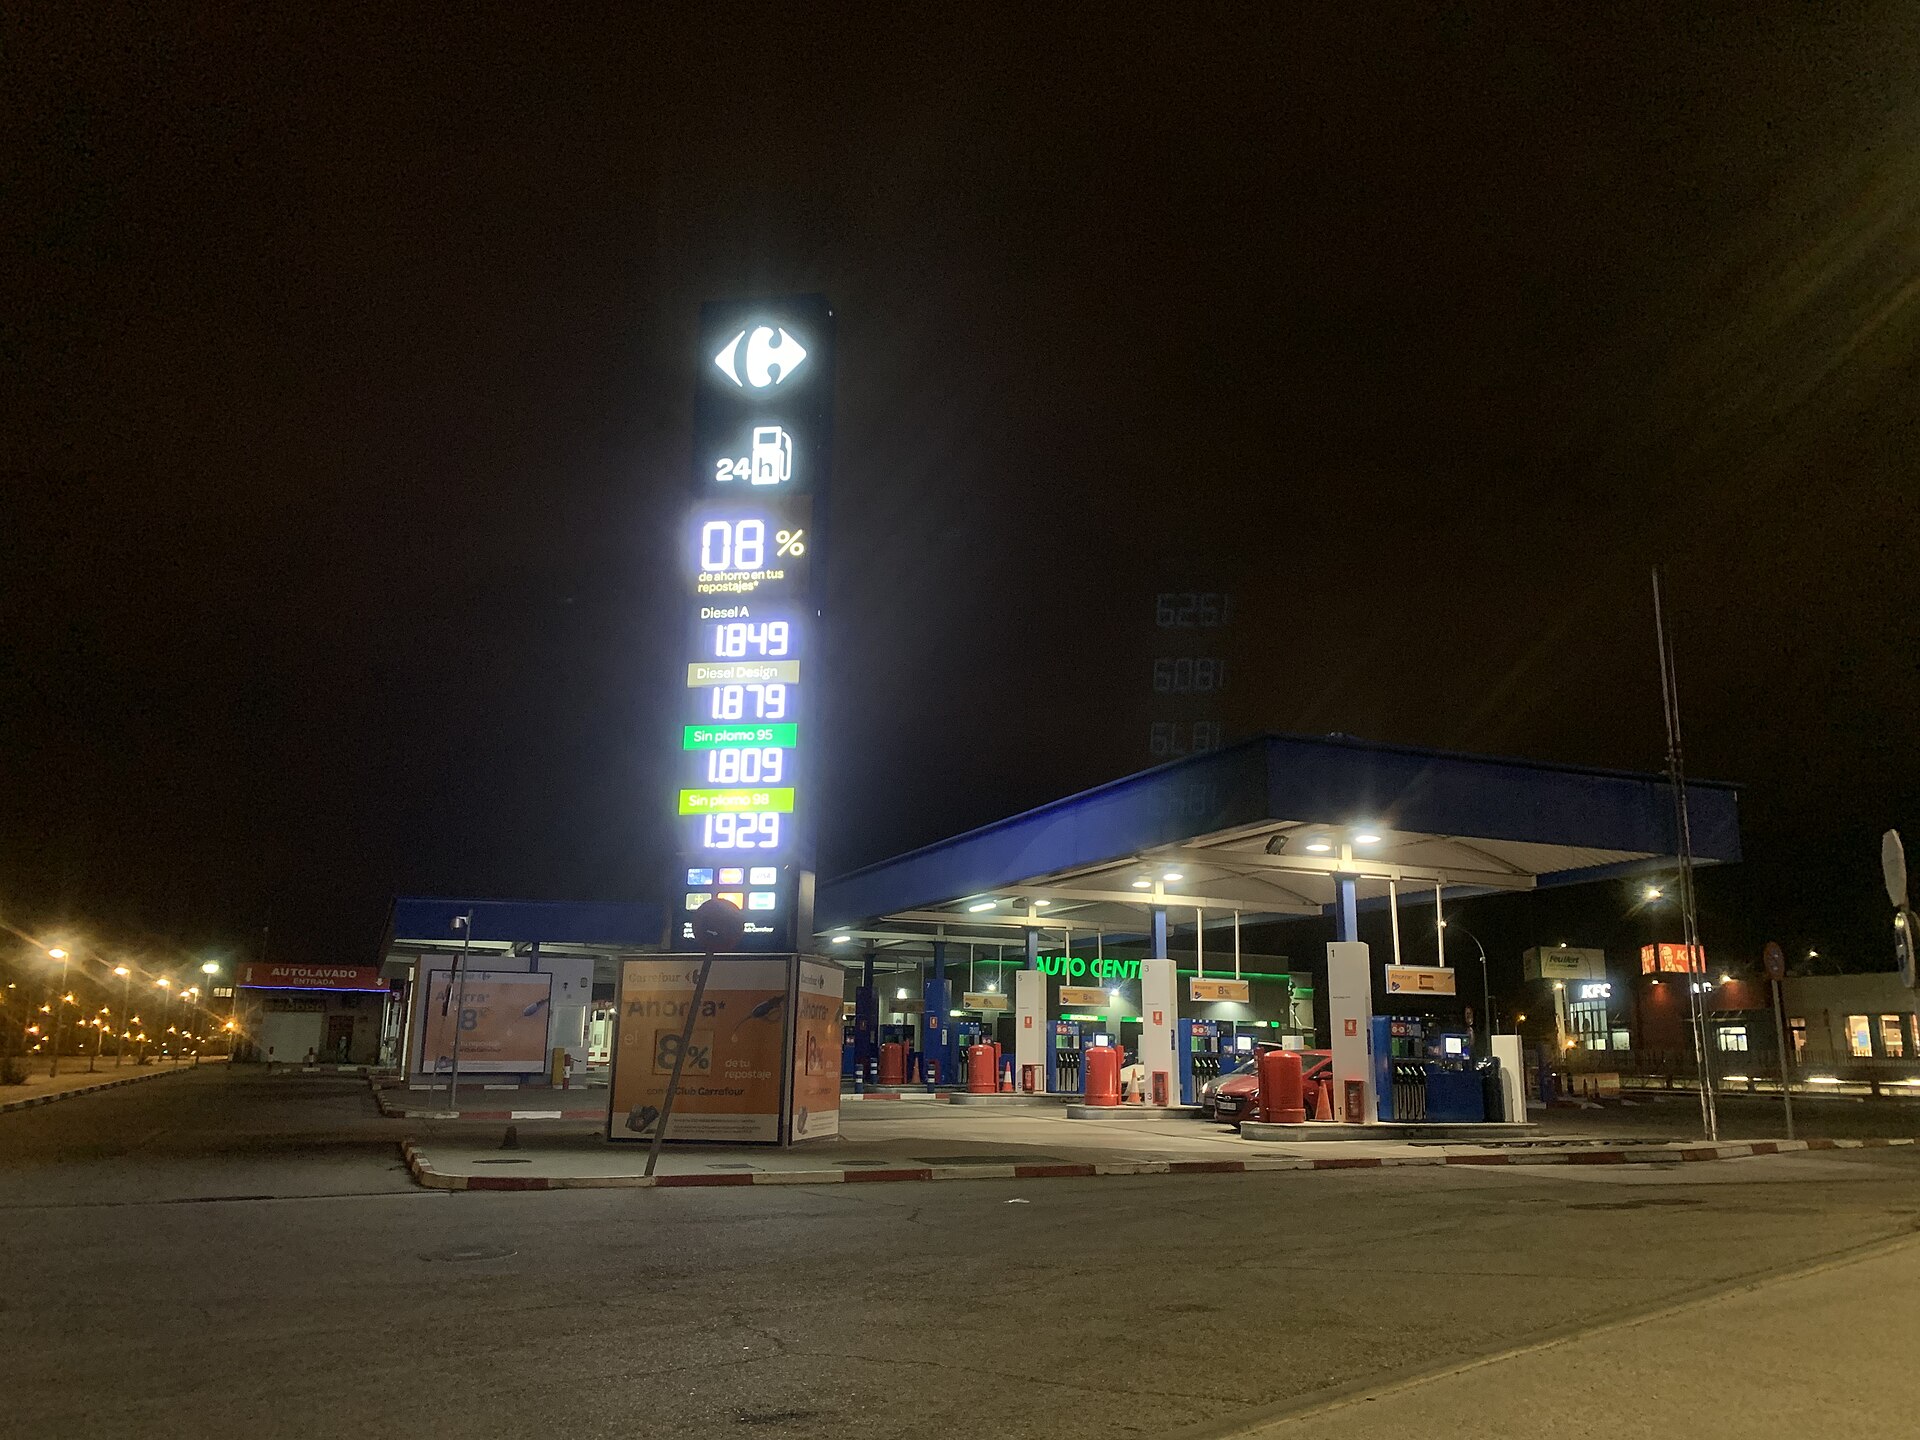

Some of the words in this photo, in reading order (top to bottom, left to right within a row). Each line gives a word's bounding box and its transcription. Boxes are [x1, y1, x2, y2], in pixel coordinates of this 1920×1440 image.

[701, 519, 765, 571] 08
[699, 572, 711, 582] de
[714, 571, 750, 581] ahorro
[751, 572, 765, 580] en
[766, 569, 784, 579] tus
[701, 606, 738, 619] Diesel
[740, 605, 749, 617] A
[697, 668, 734, 679] Diesel
[736, 666, 778, 680] Design
[694, 730, 712, 742] Sin
[715, 730, 754, 744] plomo
[757, 729, 773, 741] 95
[688, 795, 708, 807] Sin
[710, 794, 751, 807] plomo
[752, 793, 769, 805] 98
[271, 967, 358, 979] AUTOLAVADO
[1036, 956, 1086, 977] AUTO
[293, 977, 335, 986] ENTRADA
[628, 972, 682, 984] Carrefour
[1581, 982, 1612, 999] KFC
[624, 1031, 638, 1046] el
[725, 1058, 739, 1068] de
[724, 1070, 772, 1082] repostaje
[698, 1086, 745, 1096] Carrefour
